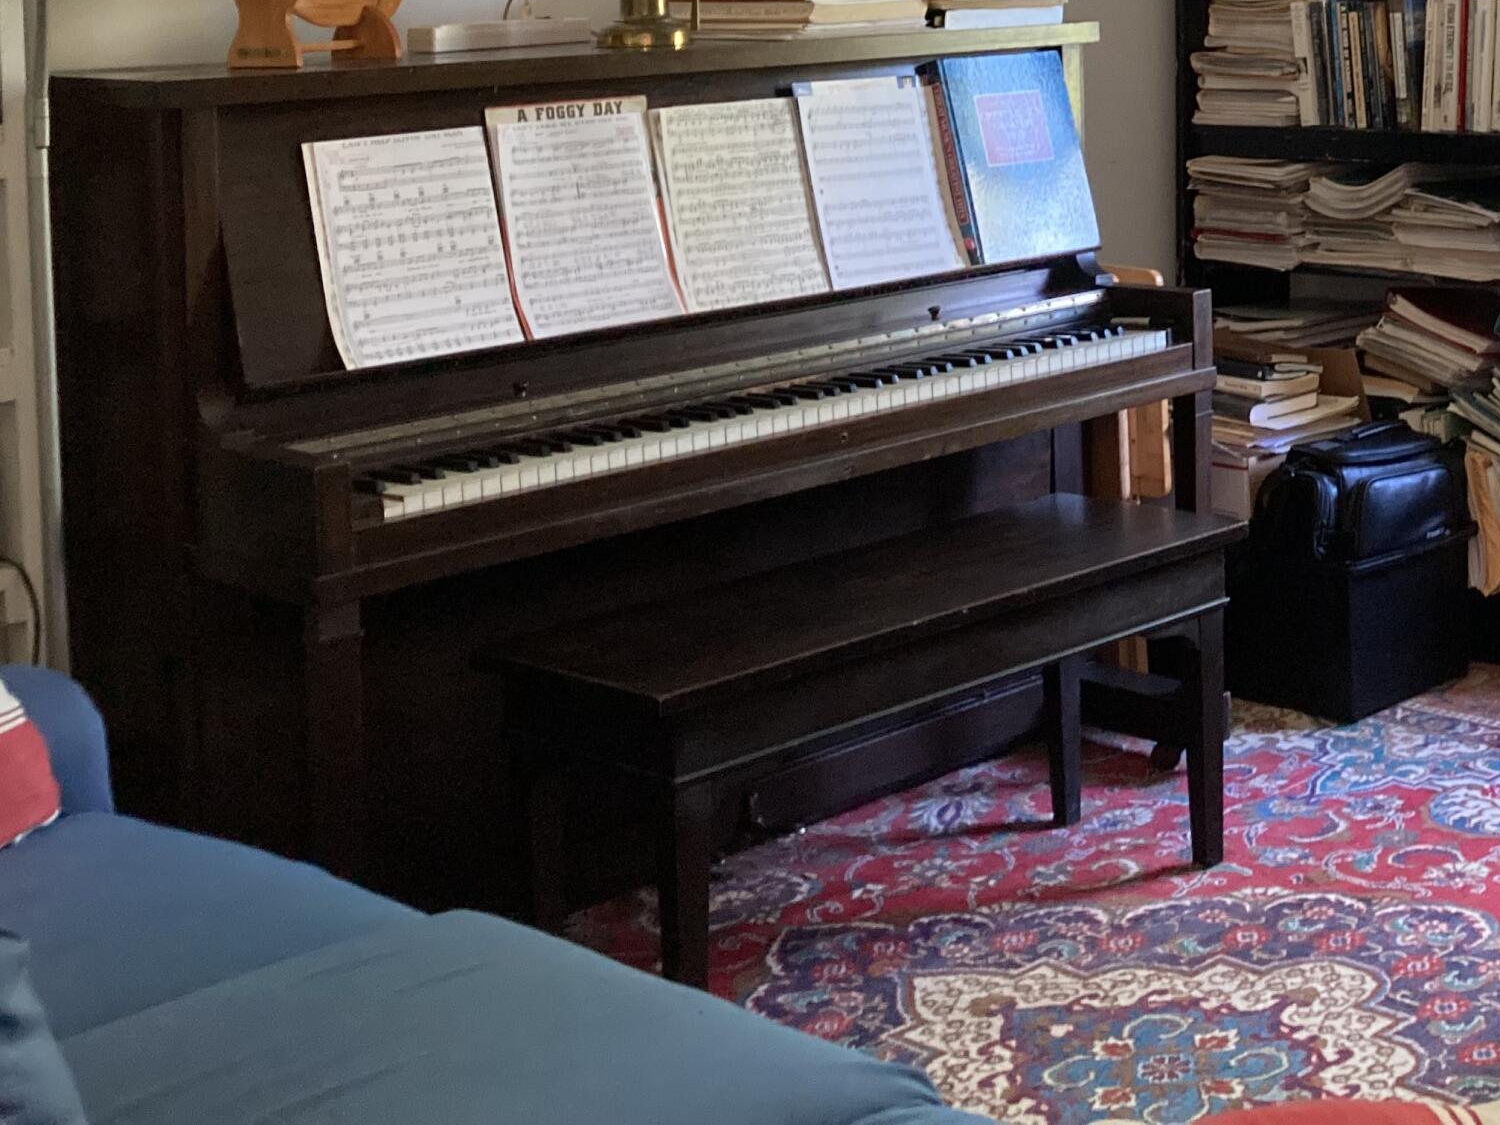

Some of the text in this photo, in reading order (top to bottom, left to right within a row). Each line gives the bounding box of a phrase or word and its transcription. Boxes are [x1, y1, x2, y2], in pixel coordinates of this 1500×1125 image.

[517, 100, 623, 123] A FOGGY DAY
